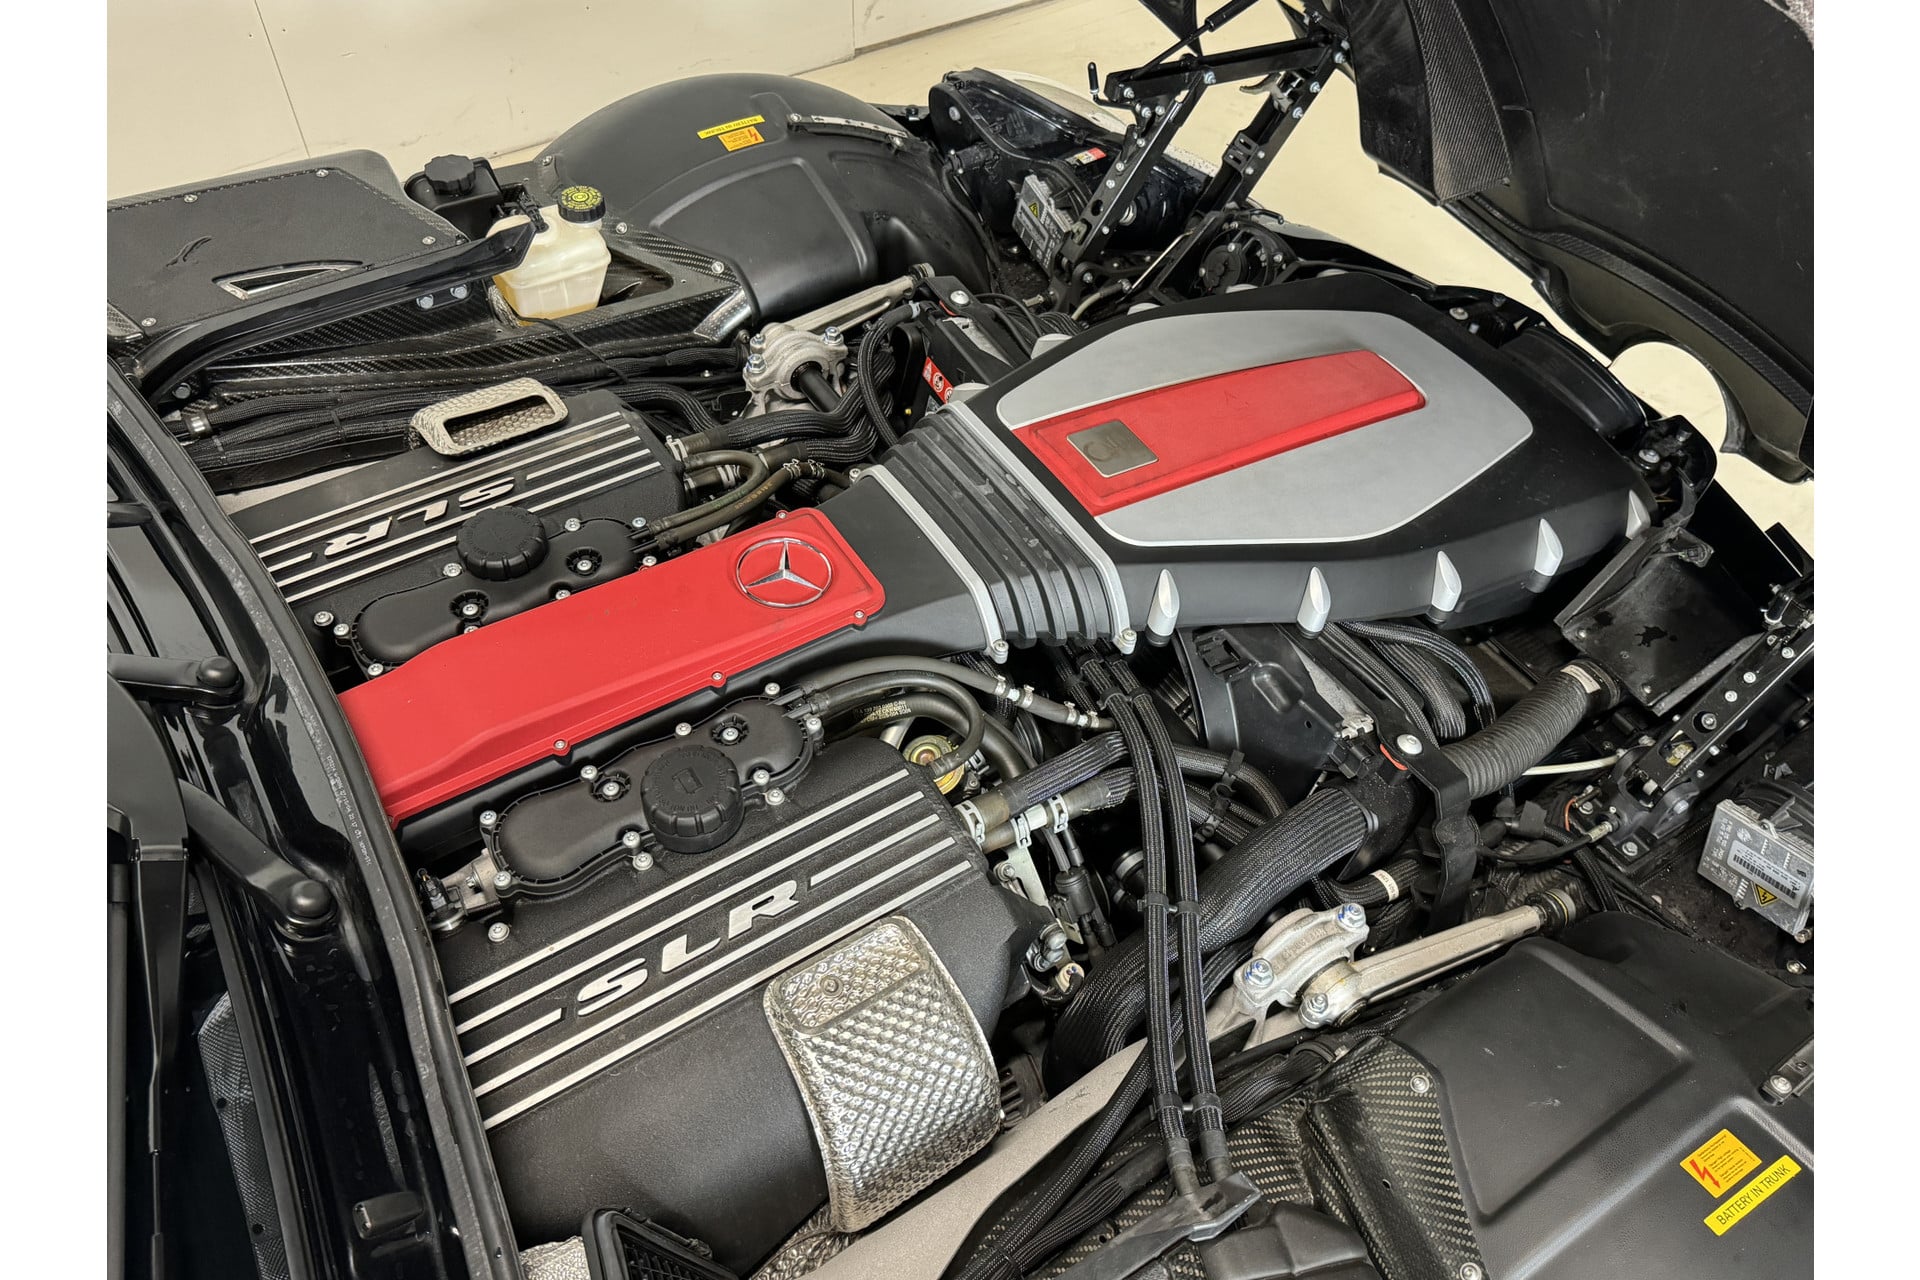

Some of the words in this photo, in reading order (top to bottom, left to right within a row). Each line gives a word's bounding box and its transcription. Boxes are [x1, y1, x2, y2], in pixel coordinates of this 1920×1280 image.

[325, 477, 515, 556] SLR
[577, 880, 799, 1016] SLR
[1716, 1191, 1754, 1225] BATTERY
[1750, 1185, 1764, 1198] IN
[1760, 1164, 1791, 1189] TRUNK
